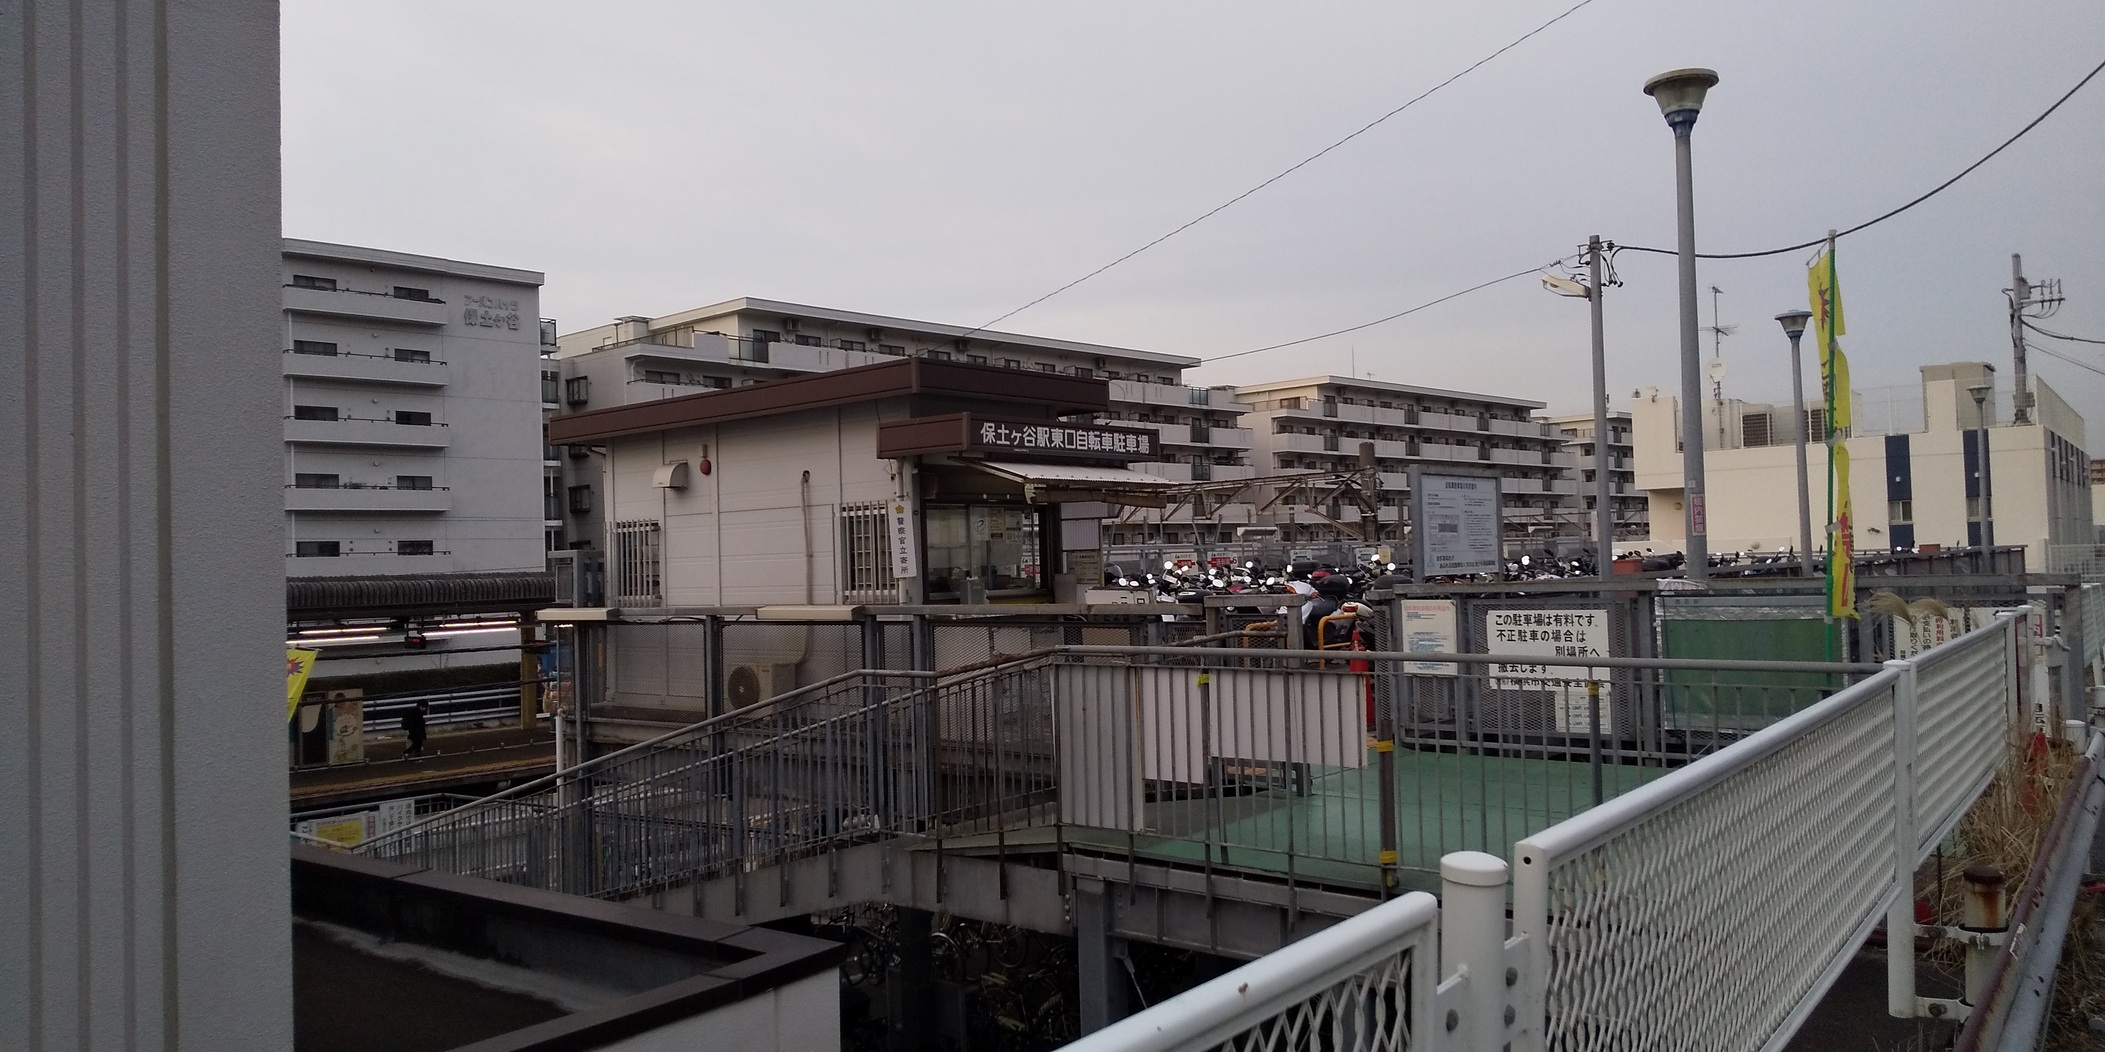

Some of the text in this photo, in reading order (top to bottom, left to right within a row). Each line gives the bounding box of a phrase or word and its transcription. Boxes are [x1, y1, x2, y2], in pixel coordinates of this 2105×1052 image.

[980, 421, 1150, 454] 保土ヶ谷駅東口自転車駐車場
[896, 516, 910, 575] 警察官立寄所
[1495, 613, 1599, 627] この駐車場は有料です。
[1496, 629, 1587, 643] 不正駐車の場合は
[1555, 645, 1601, 658] 別場所へ
